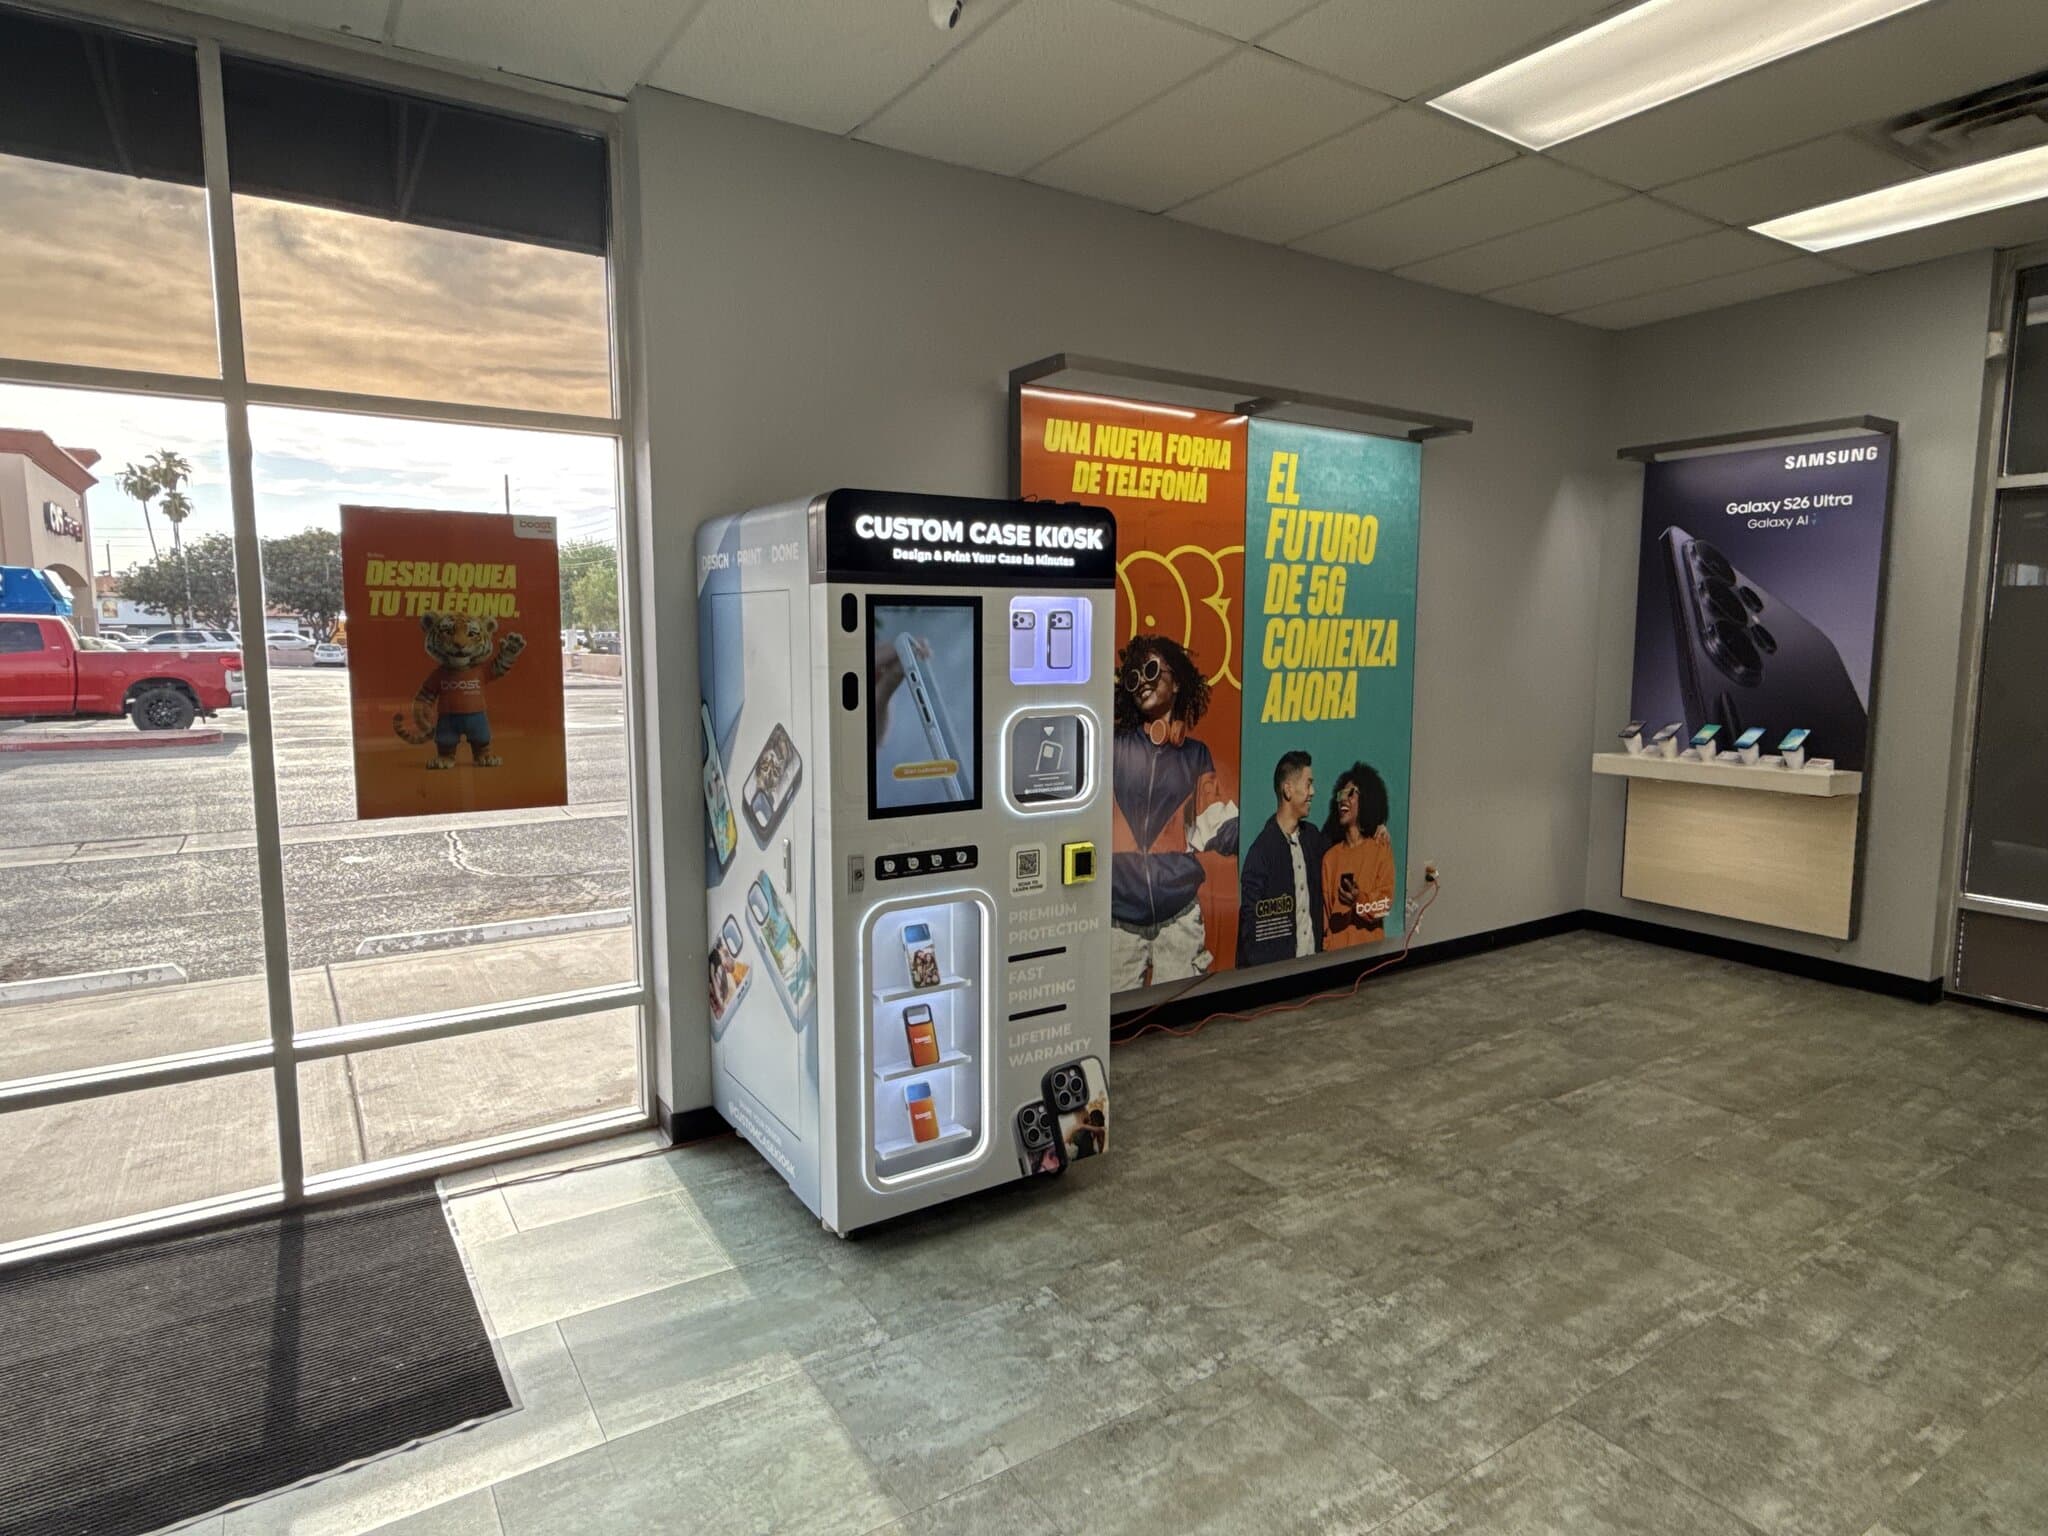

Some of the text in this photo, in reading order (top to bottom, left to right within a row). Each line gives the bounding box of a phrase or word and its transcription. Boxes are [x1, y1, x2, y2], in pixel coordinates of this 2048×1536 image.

[1044, 418, 1231, 470] UNA NUEVA FORMA
[1784, 446, 1878, 469] SAMSUNG
[1072, 460, 1208, 503] DE TELEFONÍA
[1266, 451, 1300, 505] EL
[1726, 493, 1853, 515] Galaxy S26 Ultra
[855, 514, 1104, 550] CUSTOM CASE KIOSK
[1747, 515, 1809, 529] Galaxy AI
[1265, 507, 1379, 565] FUTURO
[702, 542, 799, 570] DESIGN PRINT DONE
[893, 548, 1075, 567] Design & Print Your Case in Minutes
[365, 560, 517, 593] DESBLOQUEA
[1263, 563, 1347, 616] DE 5G
[369, 590, 400, 616] TU
[1262, 617, 1398, 669] COMIENZA
[1260, 671, 1358, 723] AHORA
[1009, 902, 1078, 924] PREMIUM
[1356, 896, 1390, 914] boost
[1009, 918, 1099, 944] PROTECTION
[1009, 966, 1044, 984] FAST
[1008, 979, 1076, 1004] PRINTING
[1009, 1023, 1072, 1048] LIFETIME
[1009, 1037, 1091, 1068] WARRANTY
